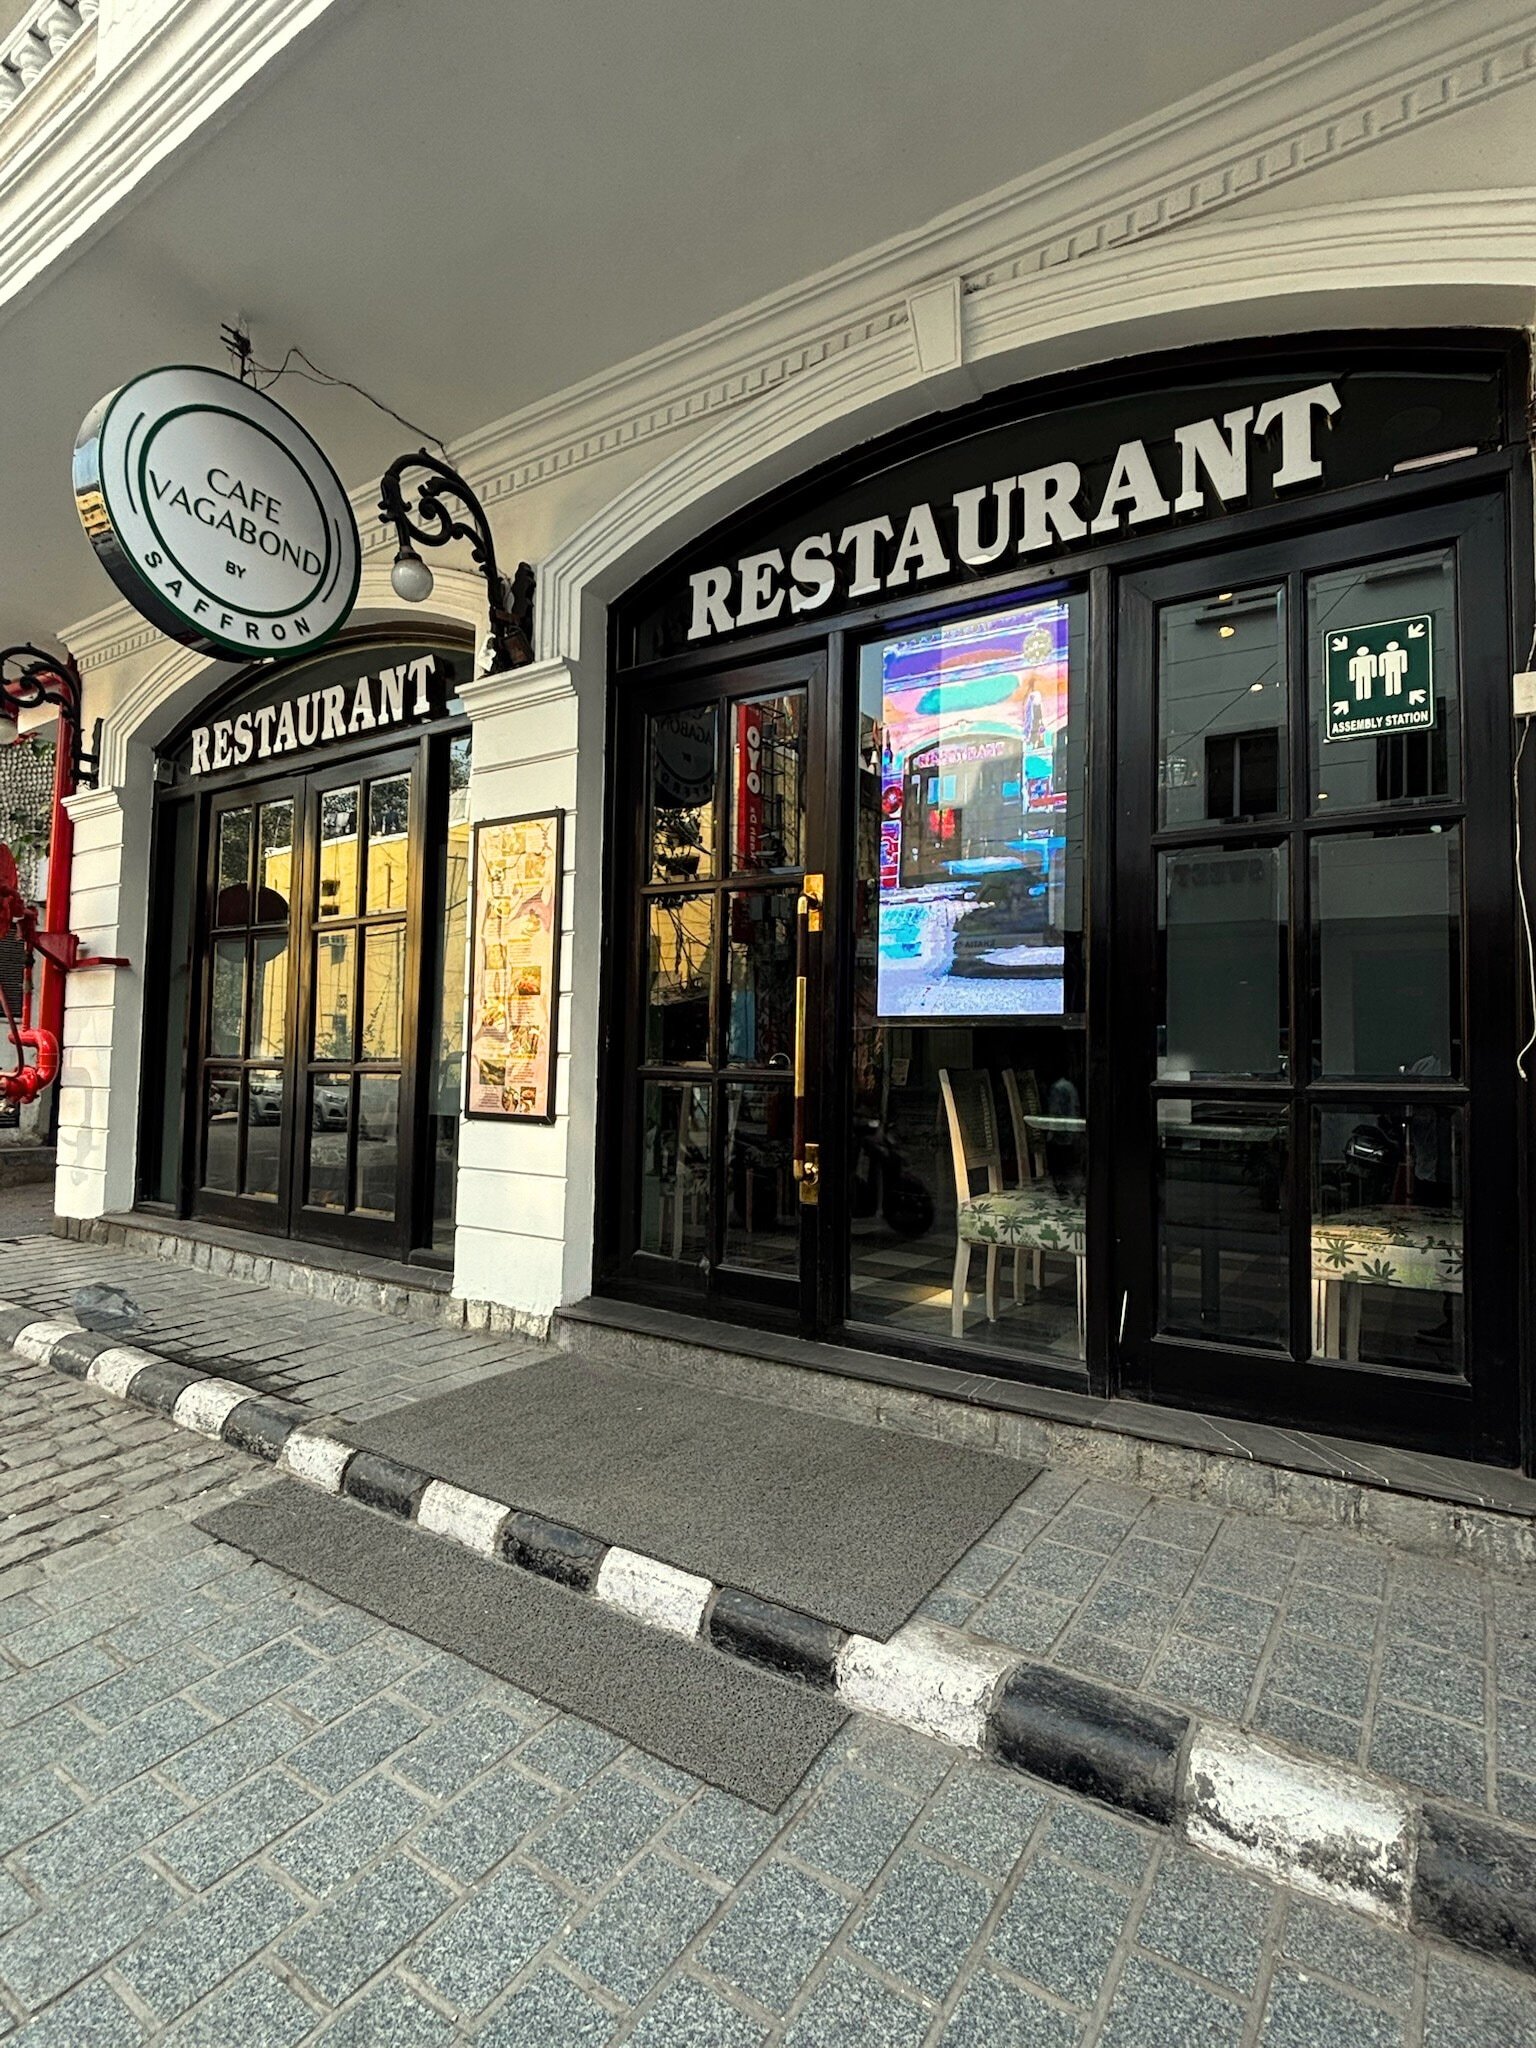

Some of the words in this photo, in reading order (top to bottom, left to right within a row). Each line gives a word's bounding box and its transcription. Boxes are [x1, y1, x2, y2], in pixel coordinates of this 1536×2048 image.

[148, 469, 322, 576] VAGABOND
[206, 468, 283, 524] CAFE
[686, 382, 1342, 641] RESTAURANT
[144, 550, 311, 641] SAFFRON
[225, 560, 247, 579] BY
[190, 653, 436, 776] RESTAURANT
[1331, 716, 1384, 735] ASSEMBLY
[1385, 710, 1429, 728] STATION
